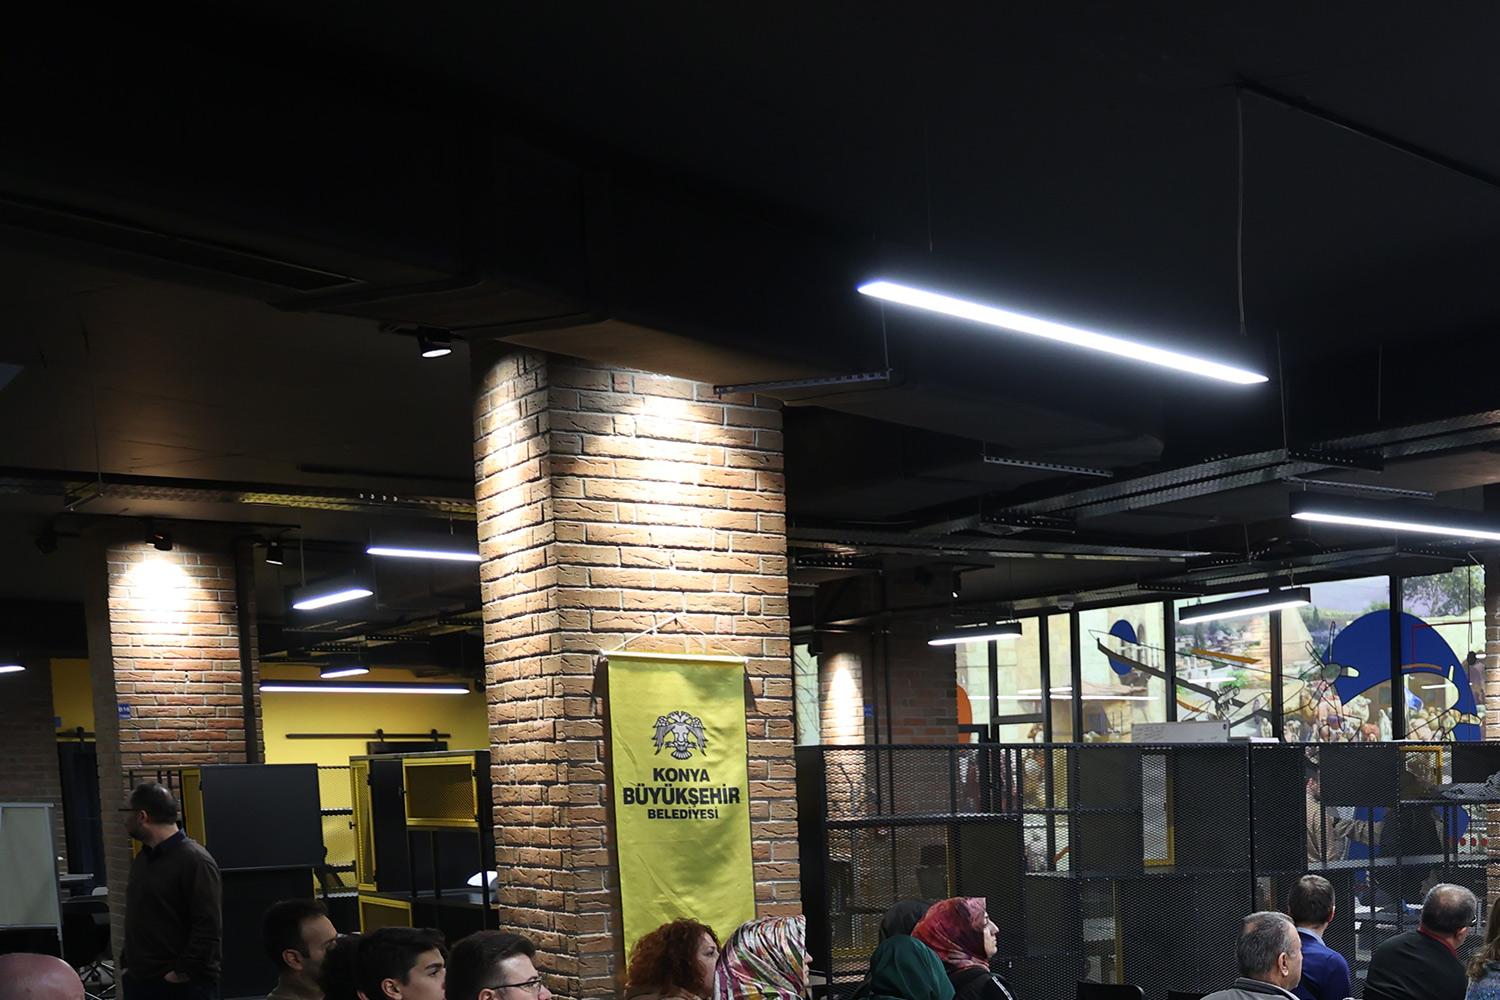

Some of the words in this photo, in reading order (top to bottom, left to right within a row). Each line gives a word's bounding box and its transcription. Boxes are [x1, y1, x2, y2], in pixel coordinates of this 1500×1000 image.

[653, 768, 710, 783] KONYA
[623, 783, 740, 808] BÜYÜKŞEHİR
[647, 806, 719, 820] BELEDİYESİ
